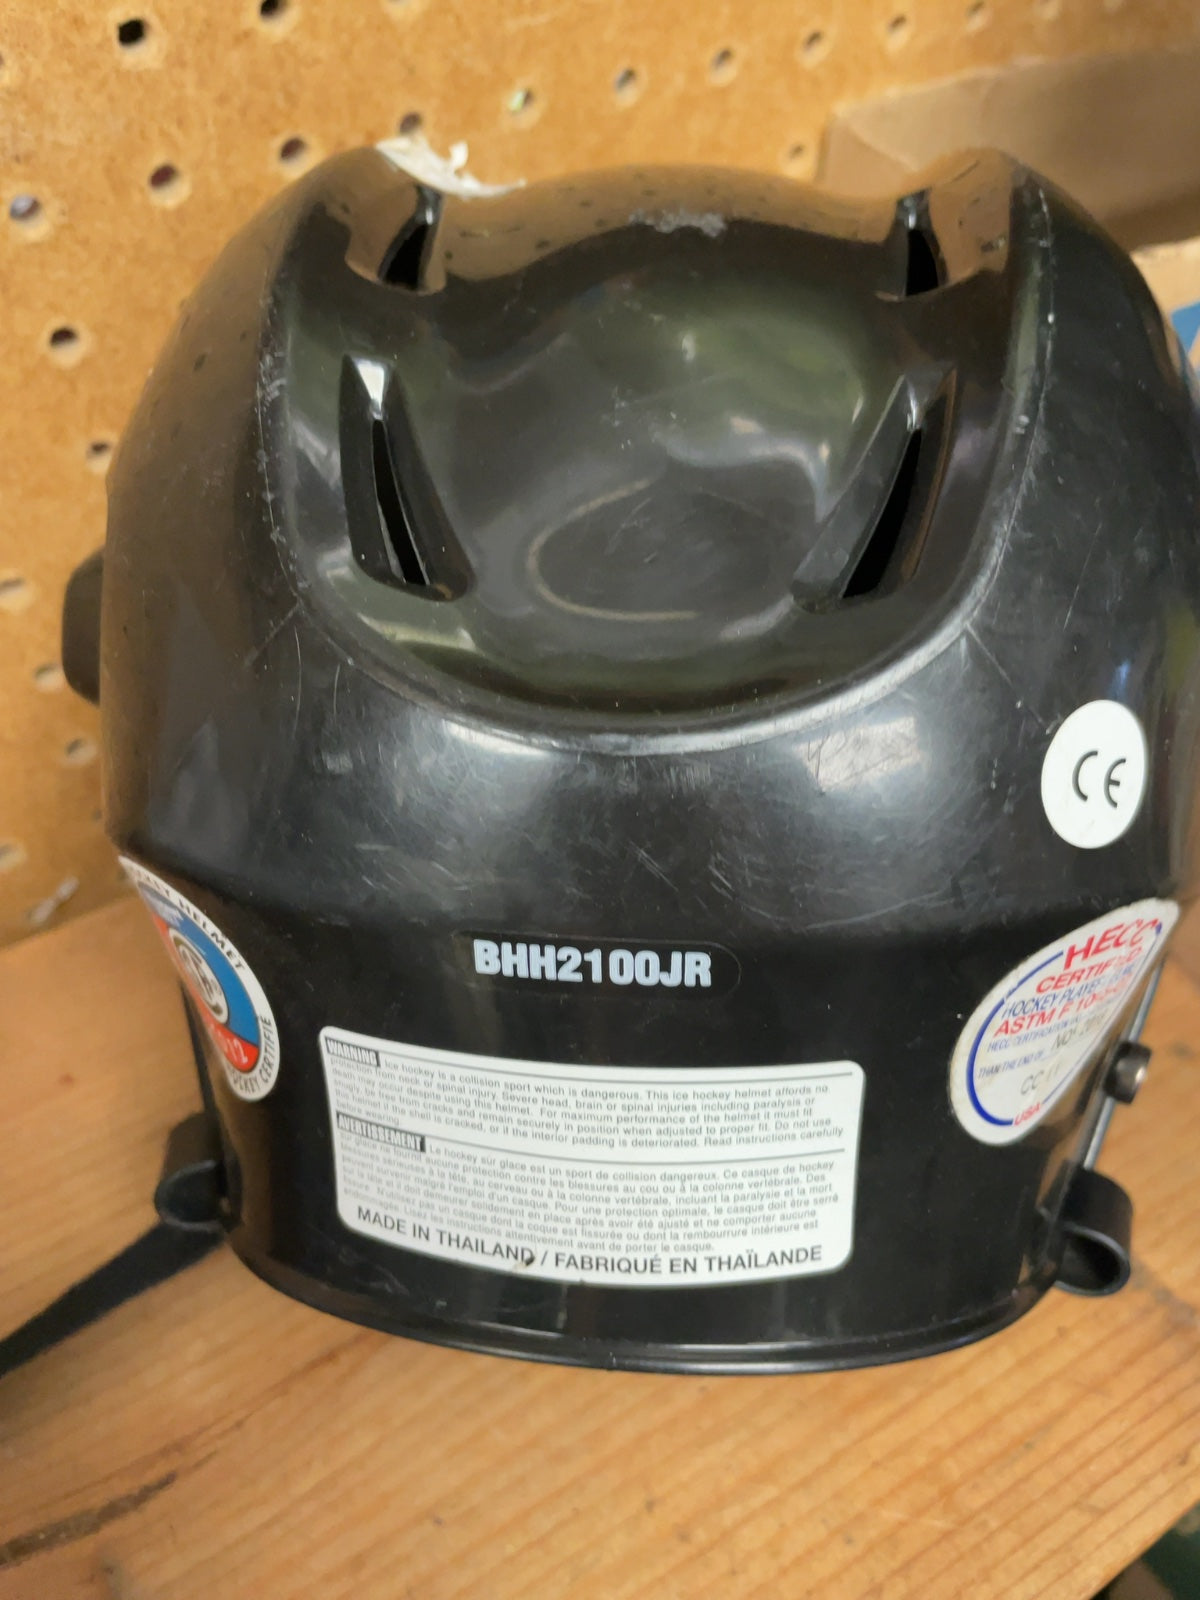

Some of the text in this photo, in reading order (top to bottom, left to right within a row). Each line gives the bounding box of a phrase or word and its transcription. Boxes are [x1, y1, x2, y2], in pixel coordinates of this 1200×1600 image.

[1072, 750, 1126, 808] CE
[1063, 918, 1159, 970] HECC
[473, 939, 711, 987] BHH2100JR
[993, 1007, 1056, 1038] ASTM
[1002, 993, 1057, 1019] HOCKEY
[328, 1039, 377, 1065] WARNING
[504, 1082, 530, 1092] sport
[534, 1084, 564, 1094] which
[647, 1090, 668, 1099] This
[692, 1090, 730, 1100] hockey
[734, 1087, 771, 1098] helmet
[775, 1085, 810, 1095] affords
[474, 1098, 491, 1109] this
[540, 1107, 556, 1117] For
[561, 1111, 612, 1121] maximum
[616, 1113, 685, 1124] performance
[703, 1113, 719, 1122] the
[724, 1111, 760, 1121] helmet
[803, 1106, 813, 1115] fit
[502, 1091, 537, 1104] Severe
[575, 1099, 602, 1109] brain
[621, 1102, 653, 1113] spinal
[657, 1102, 696, 1113] injuries
[338, 1114, 421, 1150] AVERTISSEMENT
[512, 1127, 527, 1137] the
[531, 1130, 567, 1141] interior
[572, 1134, 614, 1147] padding
[622, 1125, 651, 1134] when
[656, 1126, 702, 1137] adjusted
[719, 1125, 753, 1136] proper
[358, 1206, 822, 1275] MADE IN THAILAND / FABRIQUÉ EN THAÏLANDE
